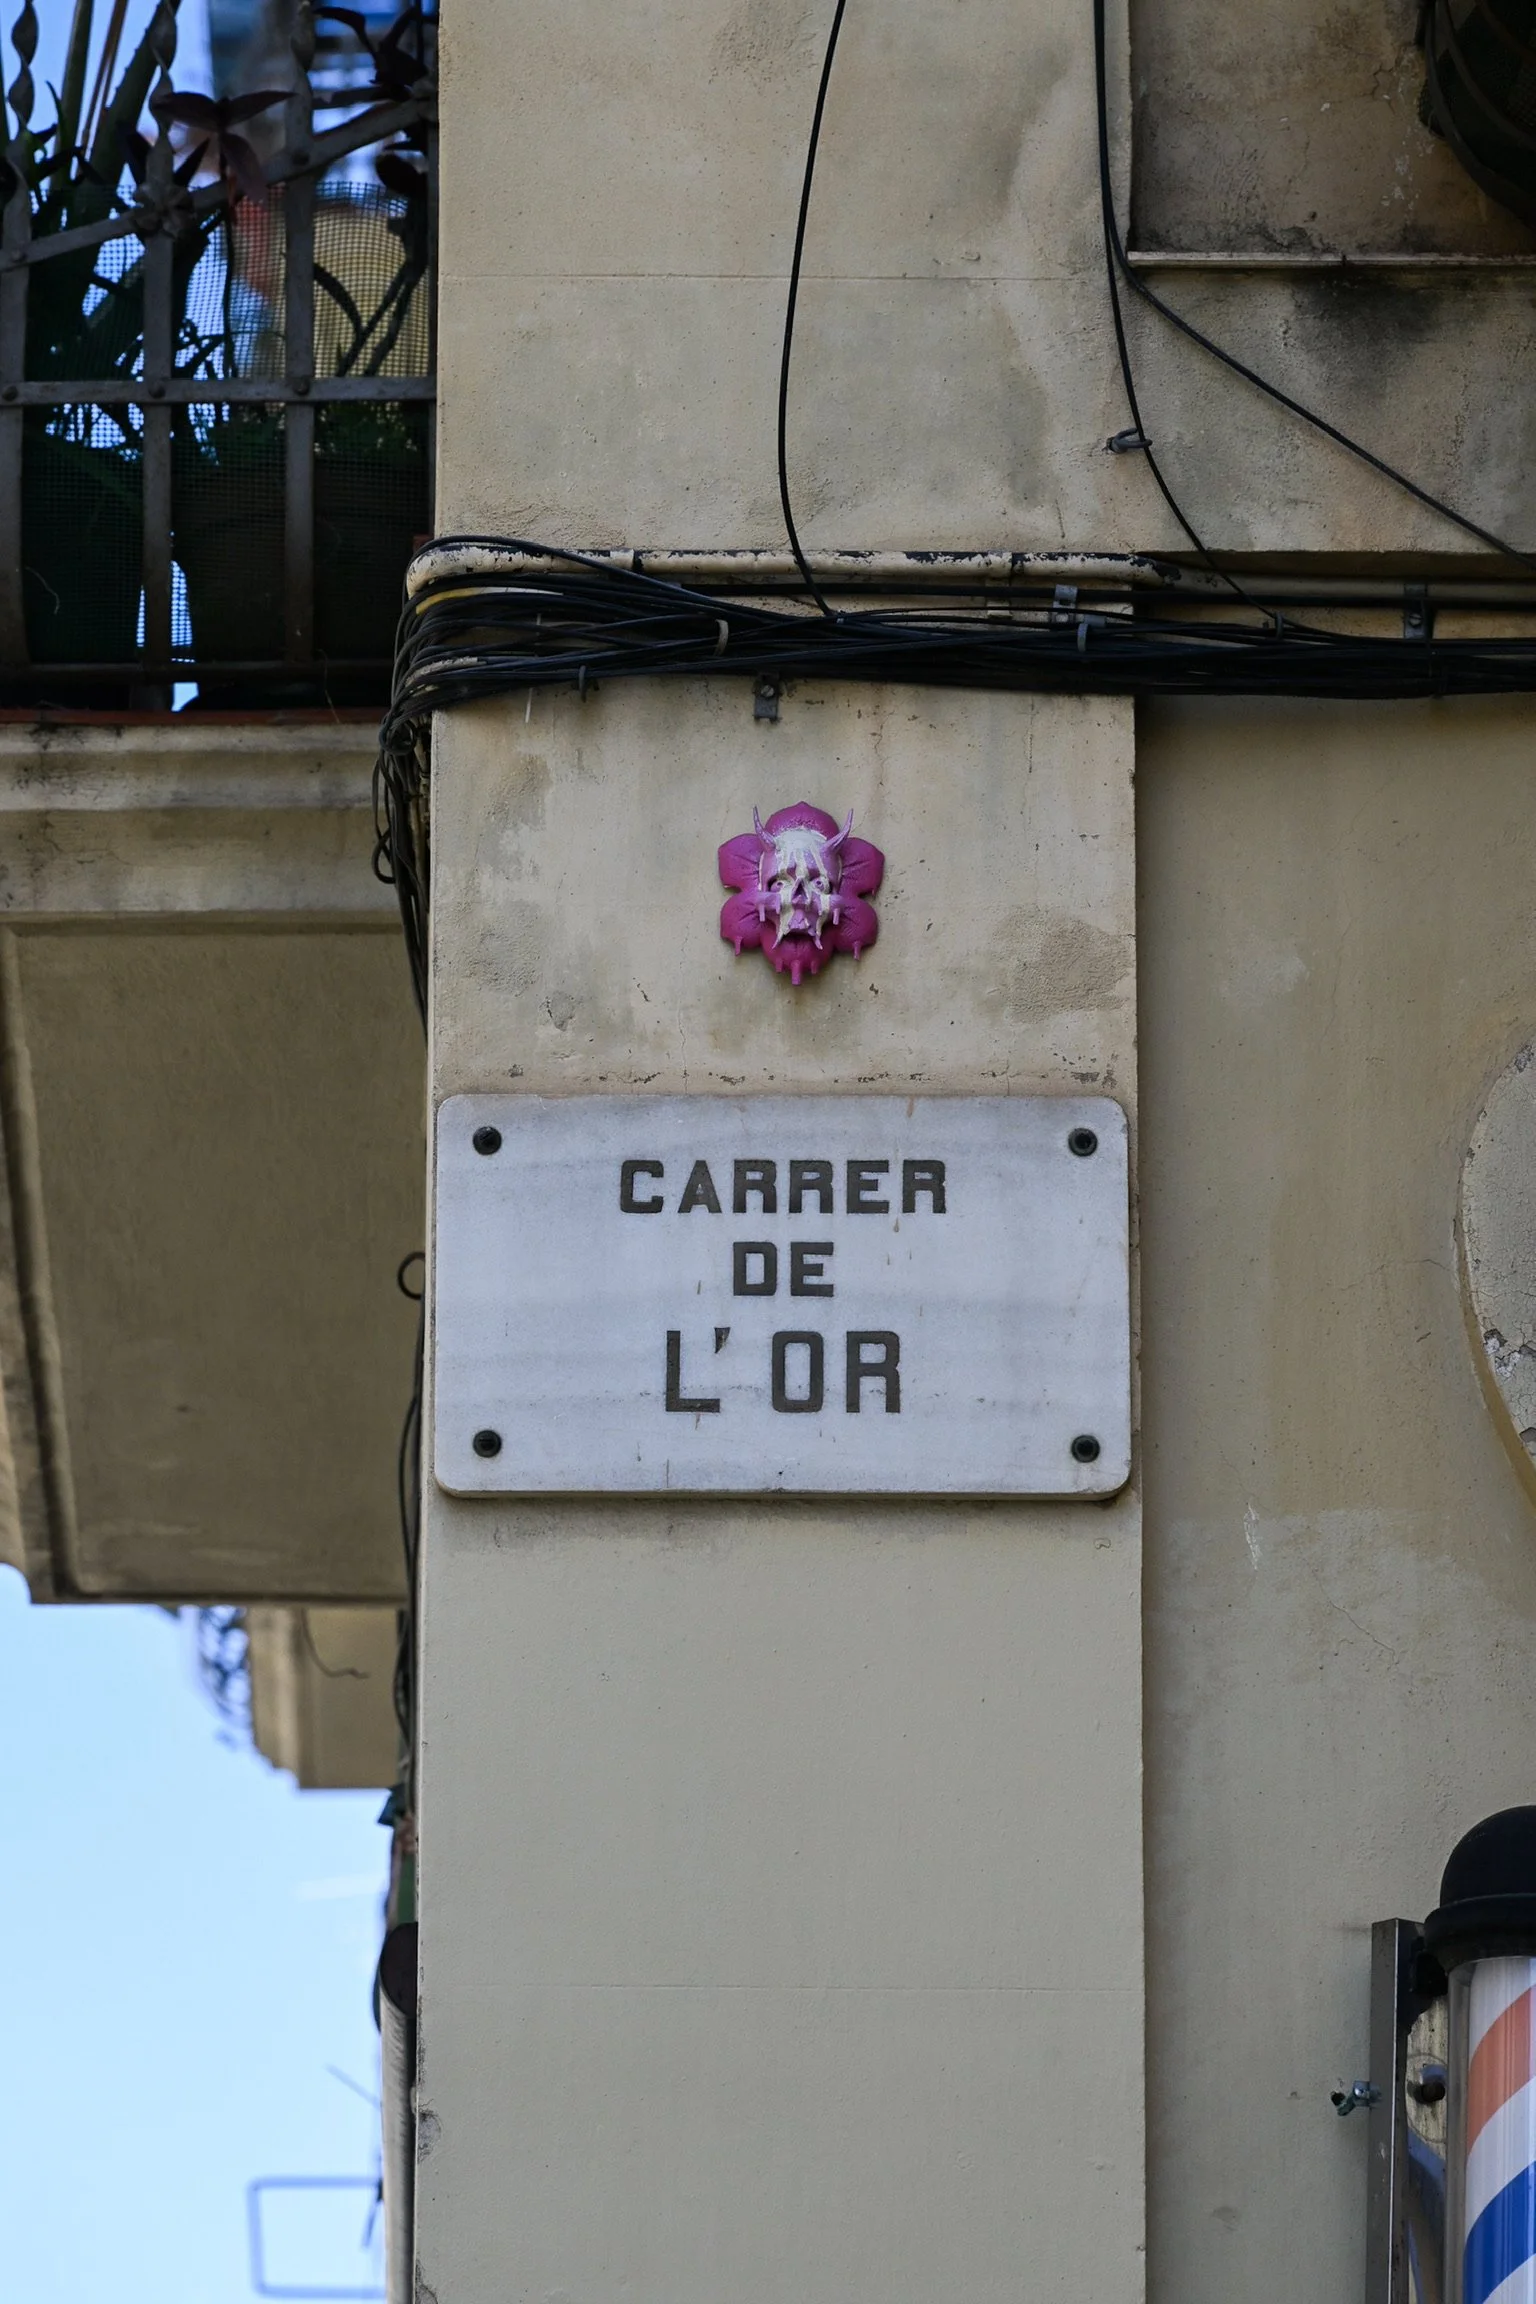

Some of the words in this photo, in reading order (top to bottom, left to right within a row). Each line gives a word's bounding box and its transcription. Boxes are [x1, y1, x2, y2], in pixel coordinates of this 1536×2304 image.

[619, 1159, 947, 1215] CARRER
[732, 1241, 835, 1298] DE
[664, 1326, 902, 1414] L'OR
